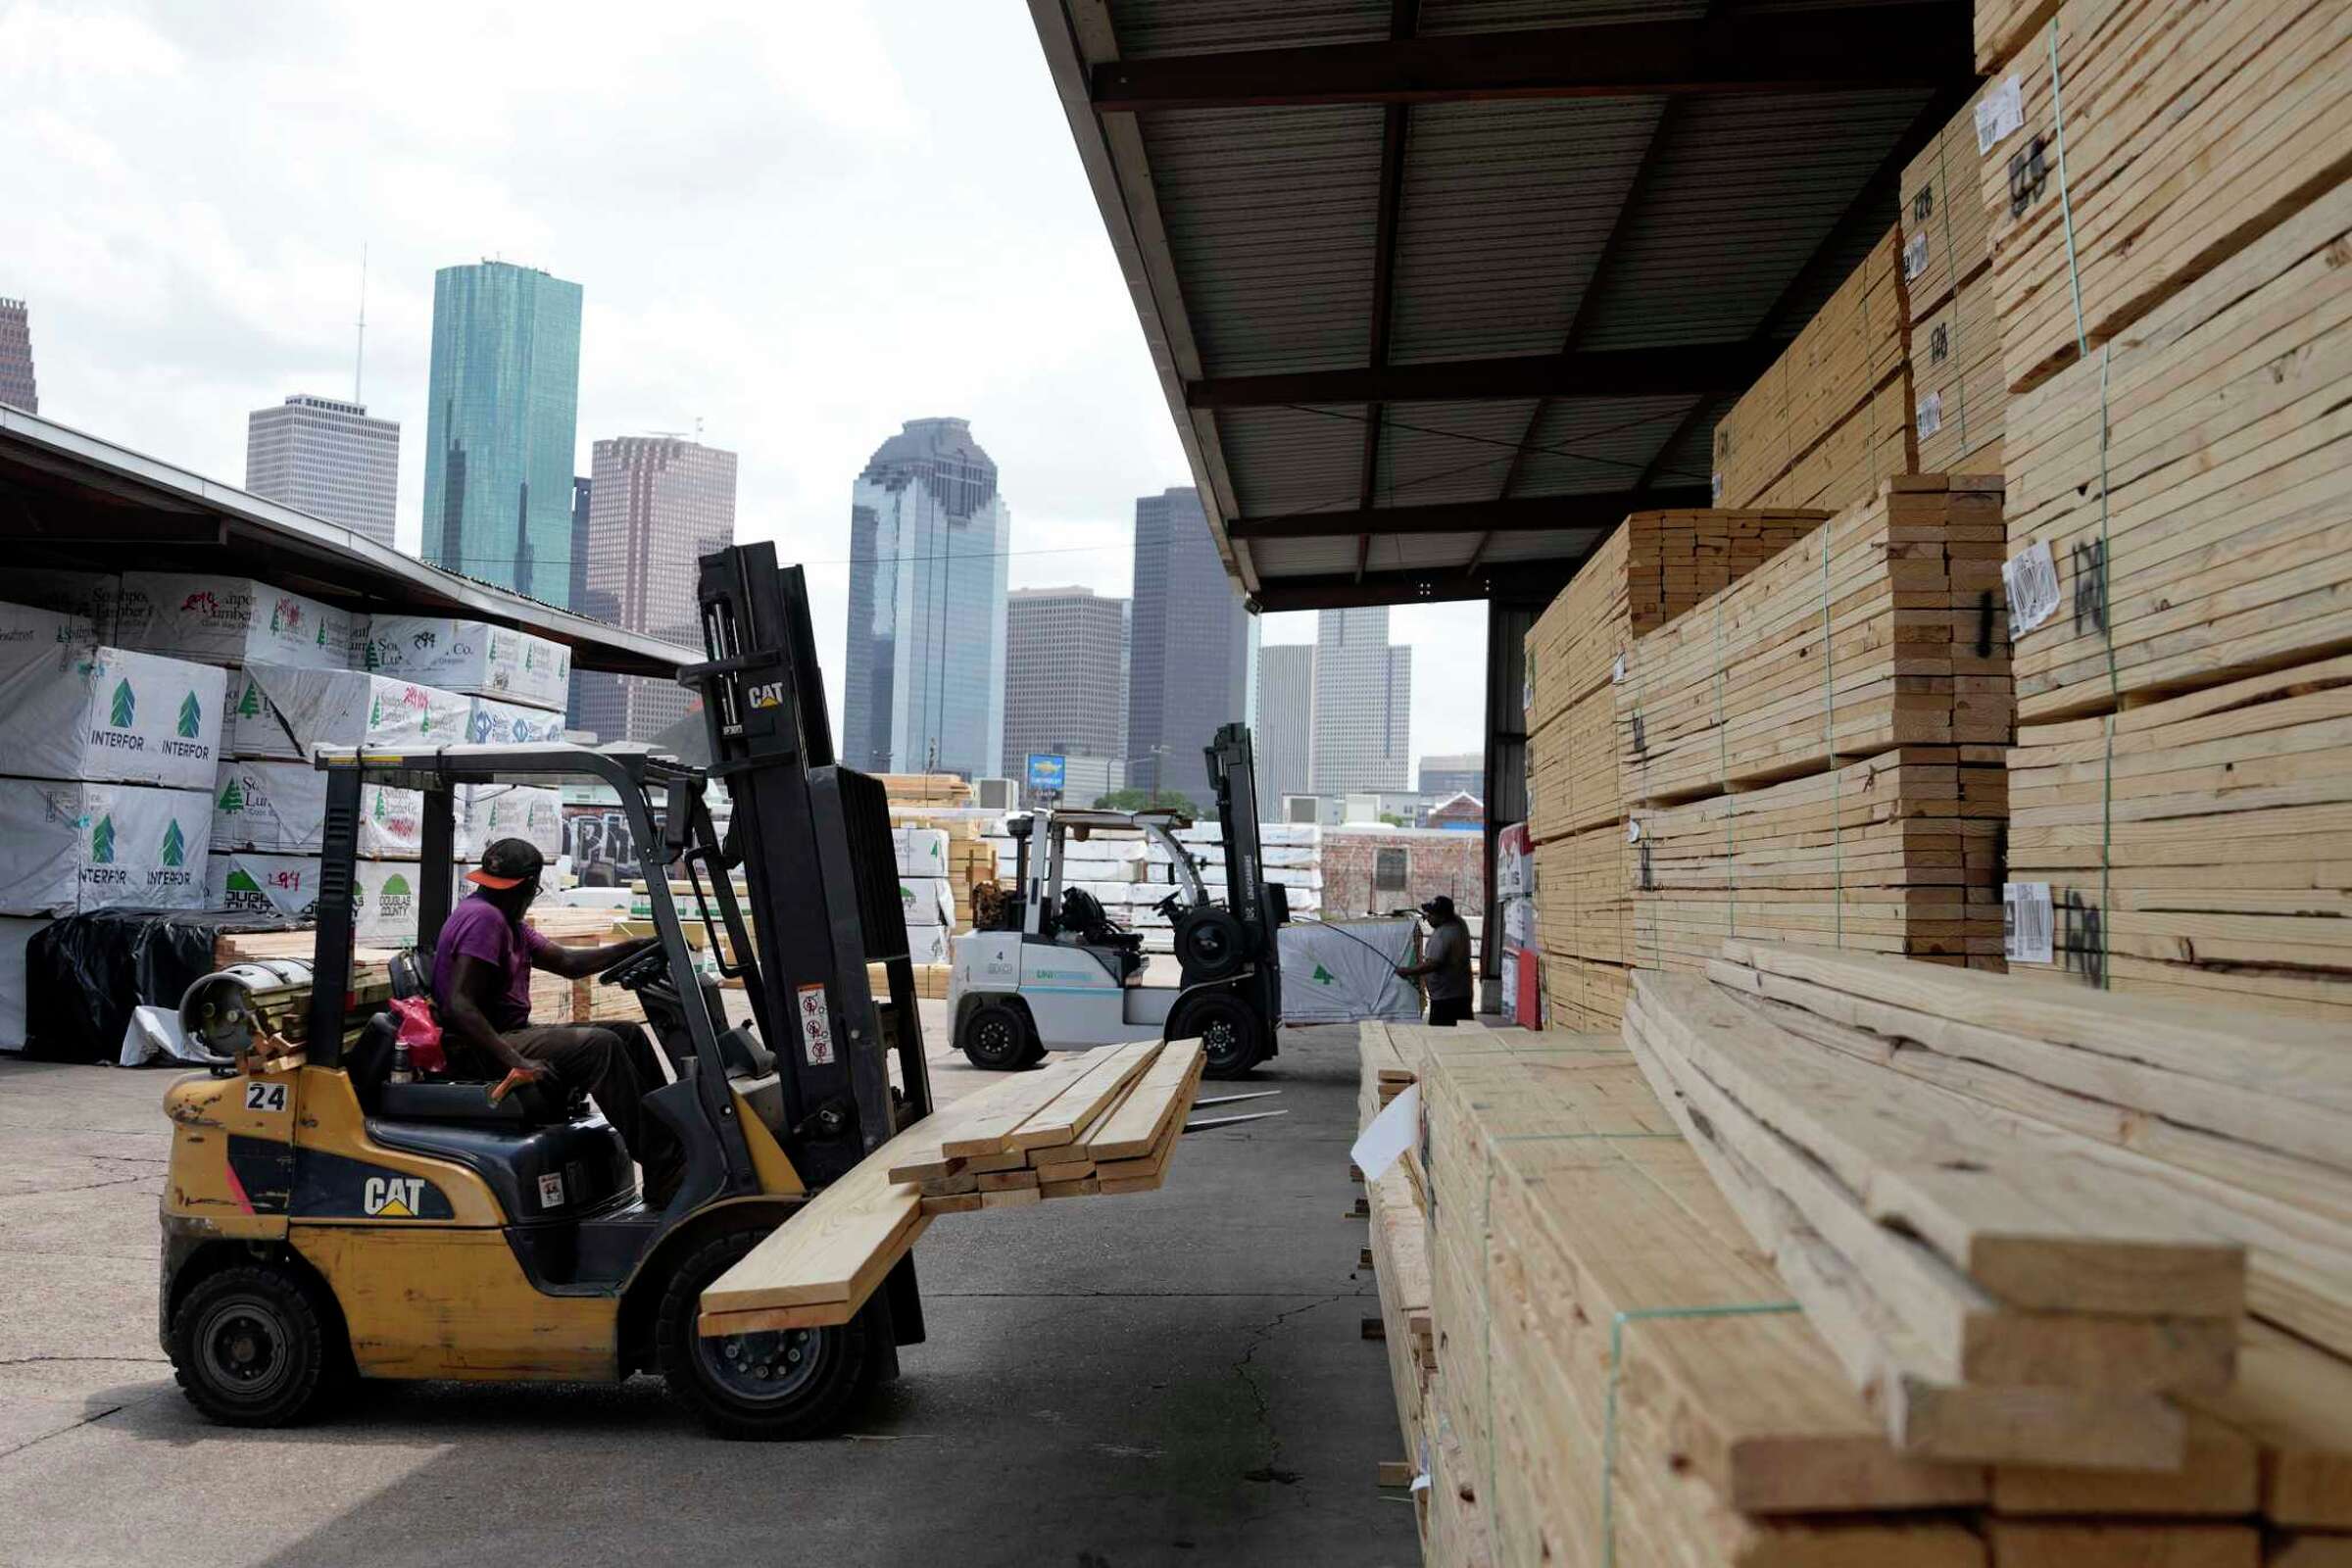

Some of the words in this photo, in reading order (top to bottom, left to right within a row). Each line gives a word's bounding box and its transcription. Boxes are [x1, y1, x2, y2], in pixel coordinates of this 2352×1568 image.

[749, 682, 784, 709] CAT
[91, 730, 144, 751] INTERFOR
[161, 740, 210, 760] INTERFOR
[79, 868, 126, 884] NTERFOR
[379, 896, 411, 906] DOUGLAS
[247, 1084, 285, 1111] 24
[365, 1177, 425, 1216] CAT
